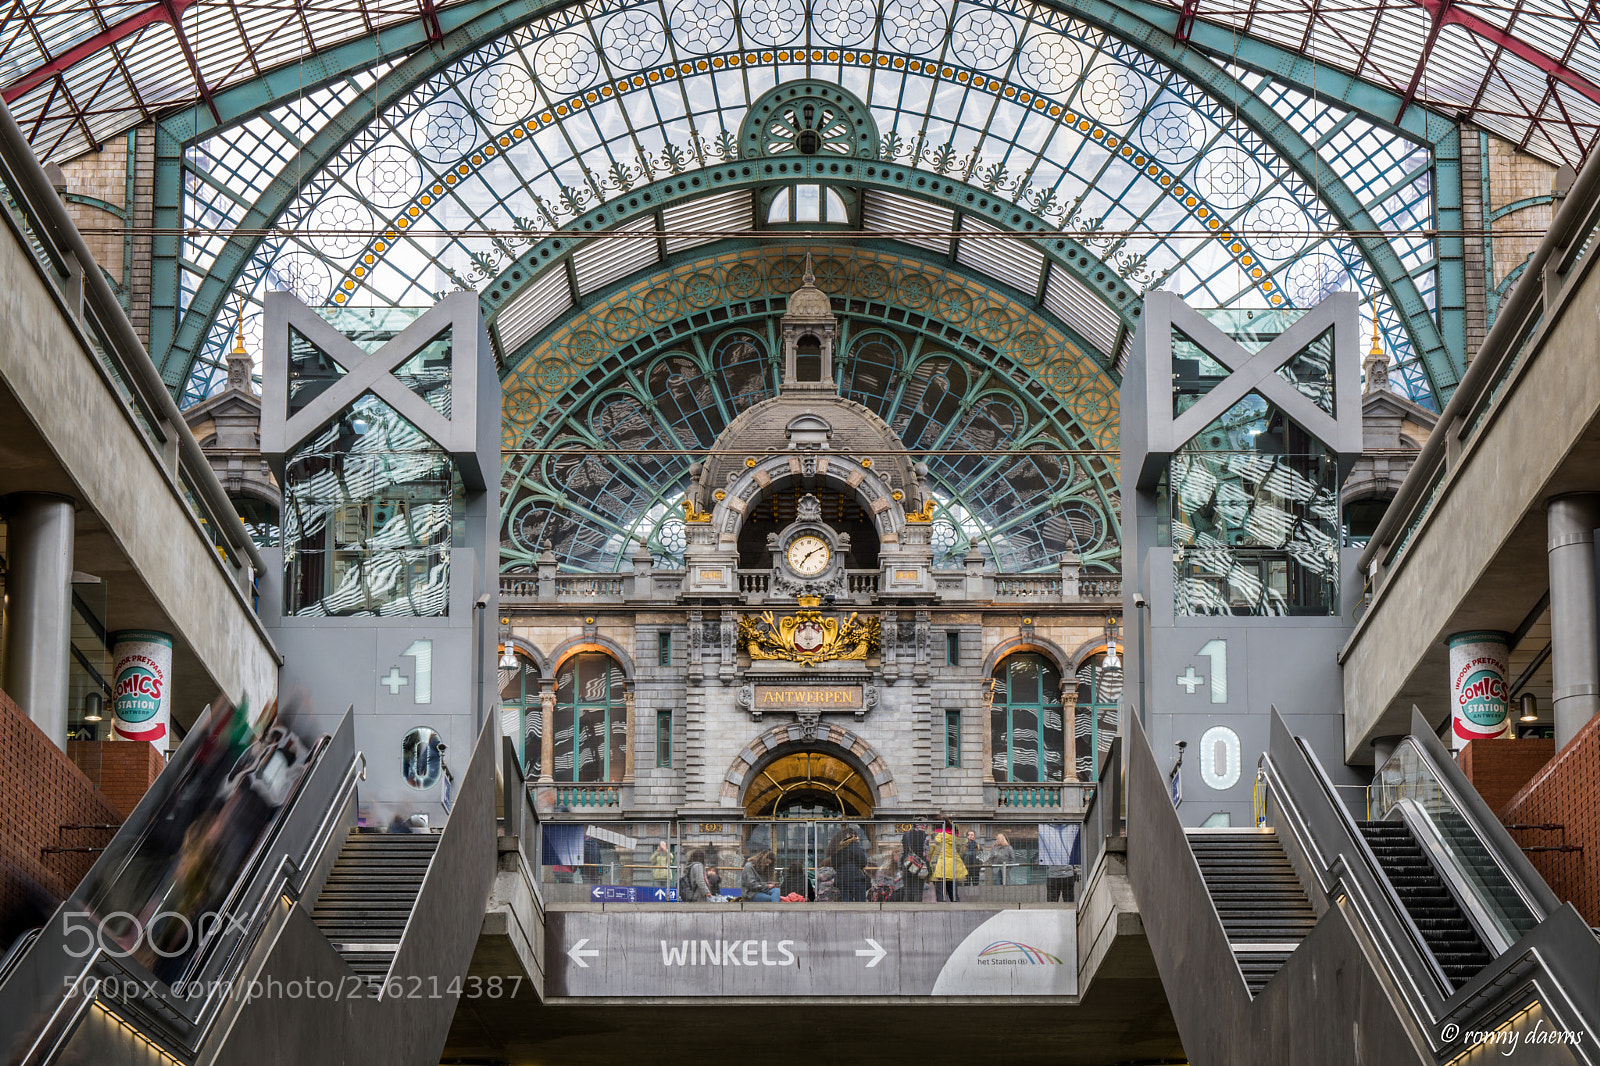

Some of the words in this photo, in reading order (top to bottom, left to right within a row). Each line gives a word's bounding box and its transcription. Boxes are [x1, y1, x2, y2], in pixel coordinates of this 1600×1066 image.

[132, 654, 165, 680] PRETPARK
[1455, 662, 1472, 690] INDOOR
[1471, 657, 1506, 675] PRETPARK
[117, 700, 155, 710] STATION
[763, 691, 852, 703] ANTWERPEN
[1467, 703, 1505, 713] STATION
[1200, 725, 1241, 791] 0
[660, 939, 795, 966] WINKELS
[977, 958, 990, 966] het
[991, 958, 1017, 966] Station
